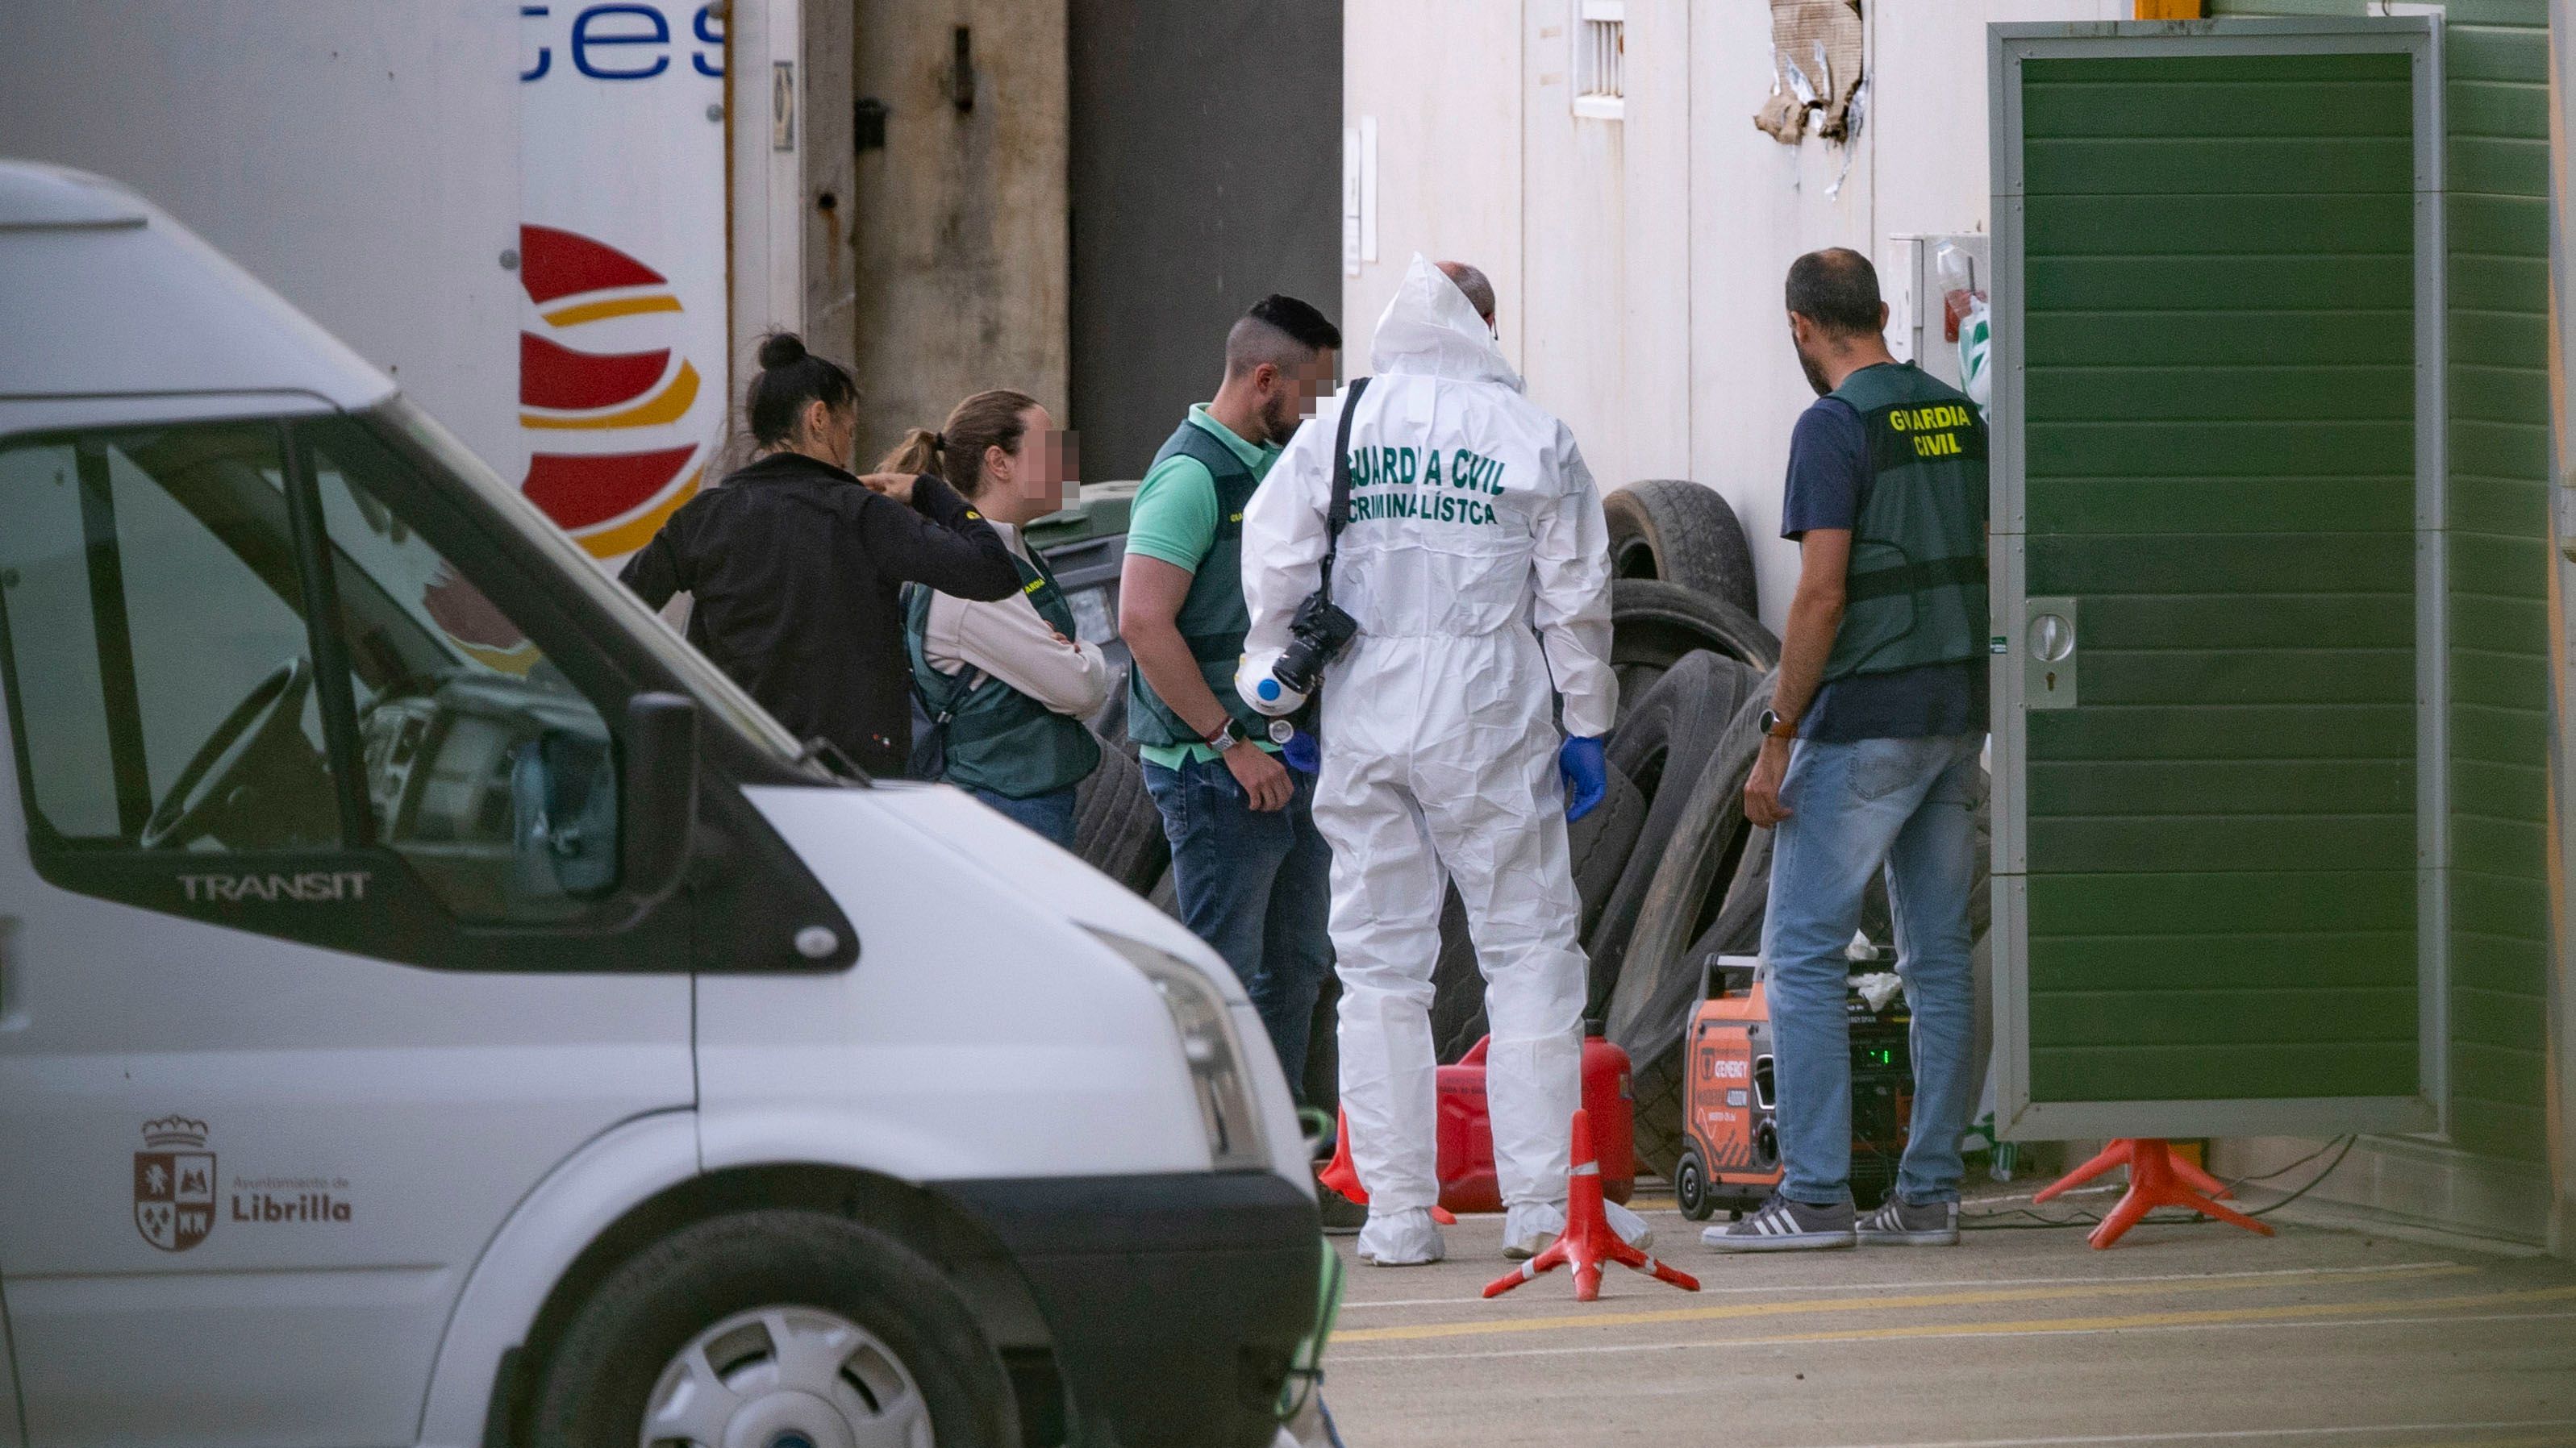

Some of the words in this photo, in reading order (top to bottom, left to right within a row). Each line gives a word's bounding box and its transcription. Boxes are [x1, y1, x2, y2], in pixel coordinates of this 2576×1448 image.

[1890, 406, 1971, 431] GUARDIA
[1913, 432, 1961, 456] CIVIL
[177, 871, 372, 901] TRANSIT
[231, 1193, 352, 1222] Librilla
